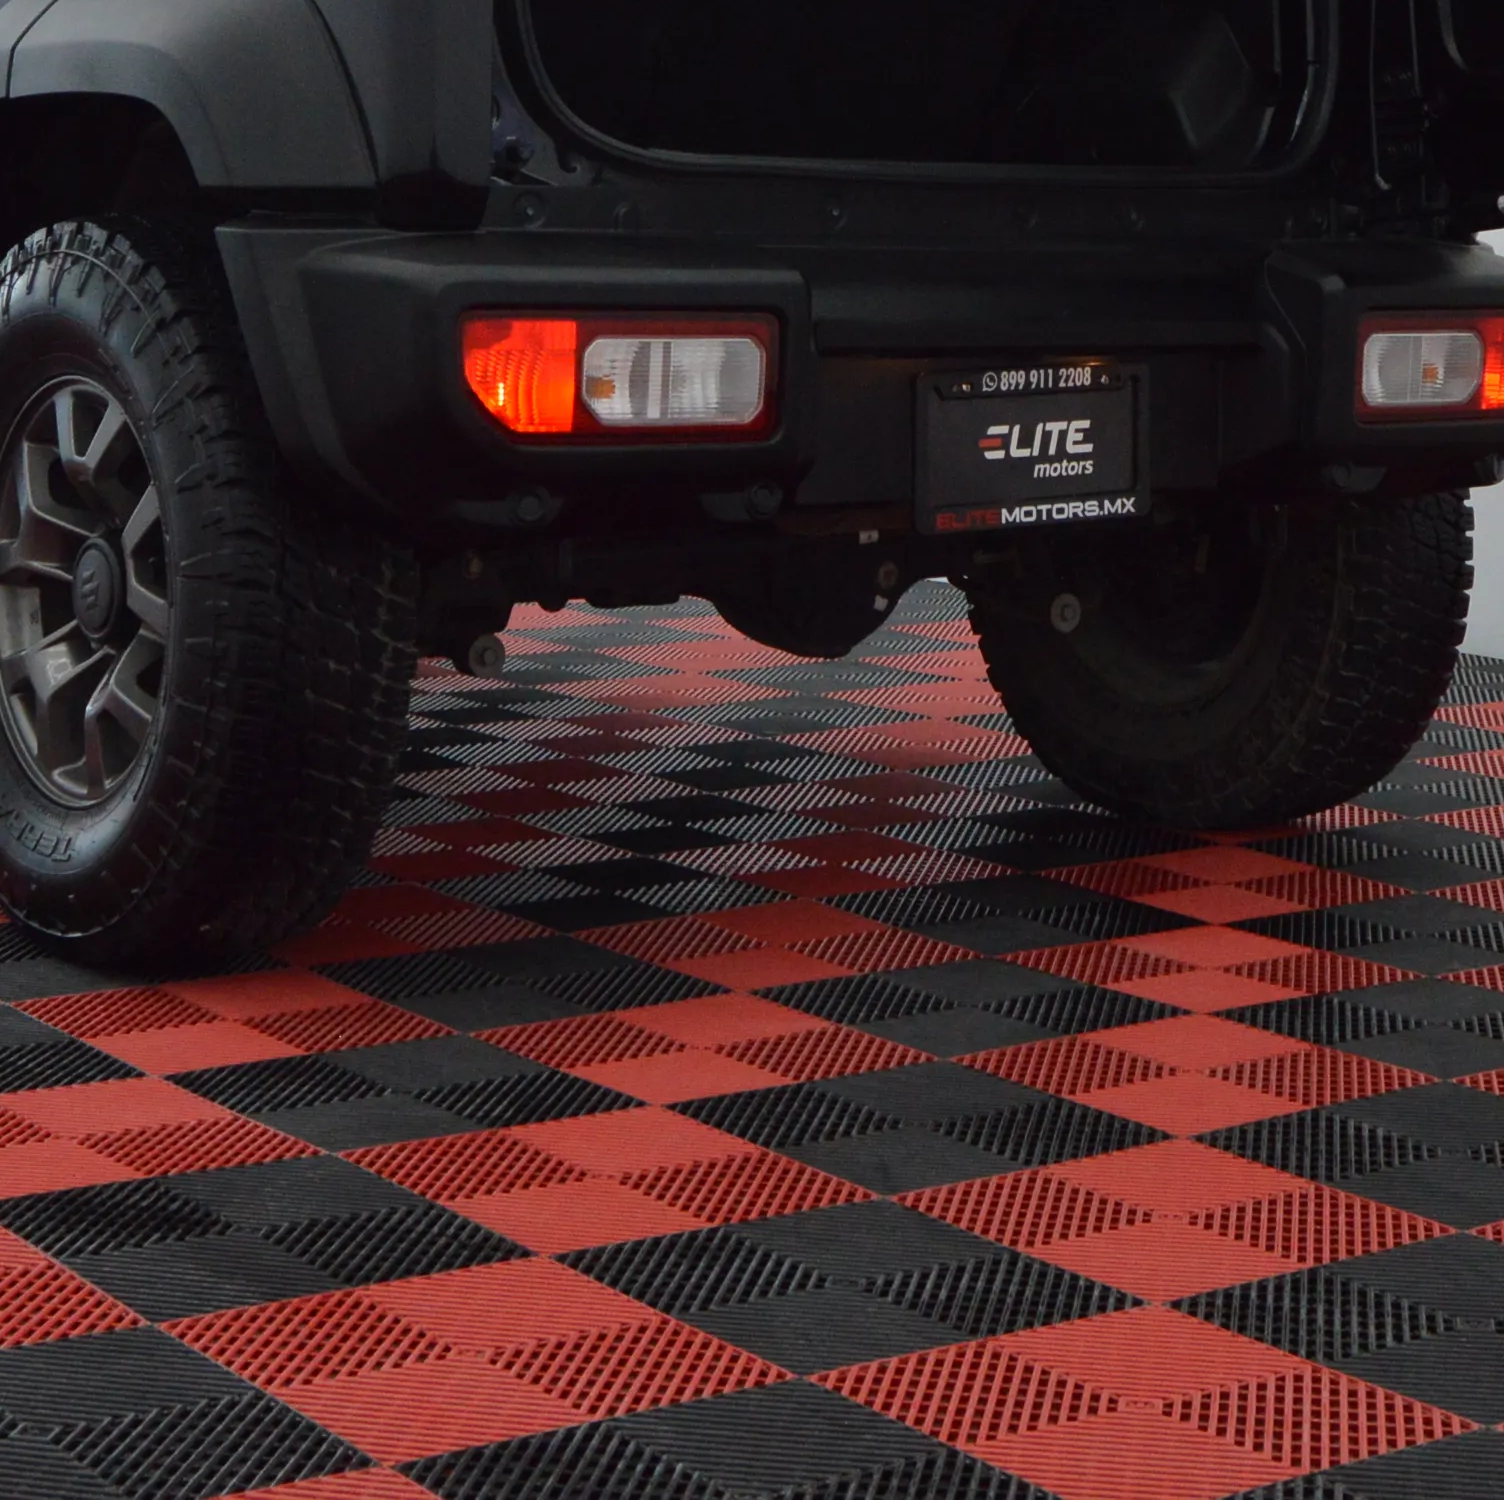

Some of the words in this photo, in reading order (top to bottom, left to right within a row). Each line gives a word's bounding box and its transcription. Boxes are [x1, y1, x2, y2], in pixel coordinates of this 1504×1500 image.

[1000, 370, 1026, 391] 899
[1029, 368, 1053, 390] 911
[1058, 366, 1092, 388] 2208
[977, 419, 1094, 460] ELITE
[1033, 458, 1094, 478] motors
